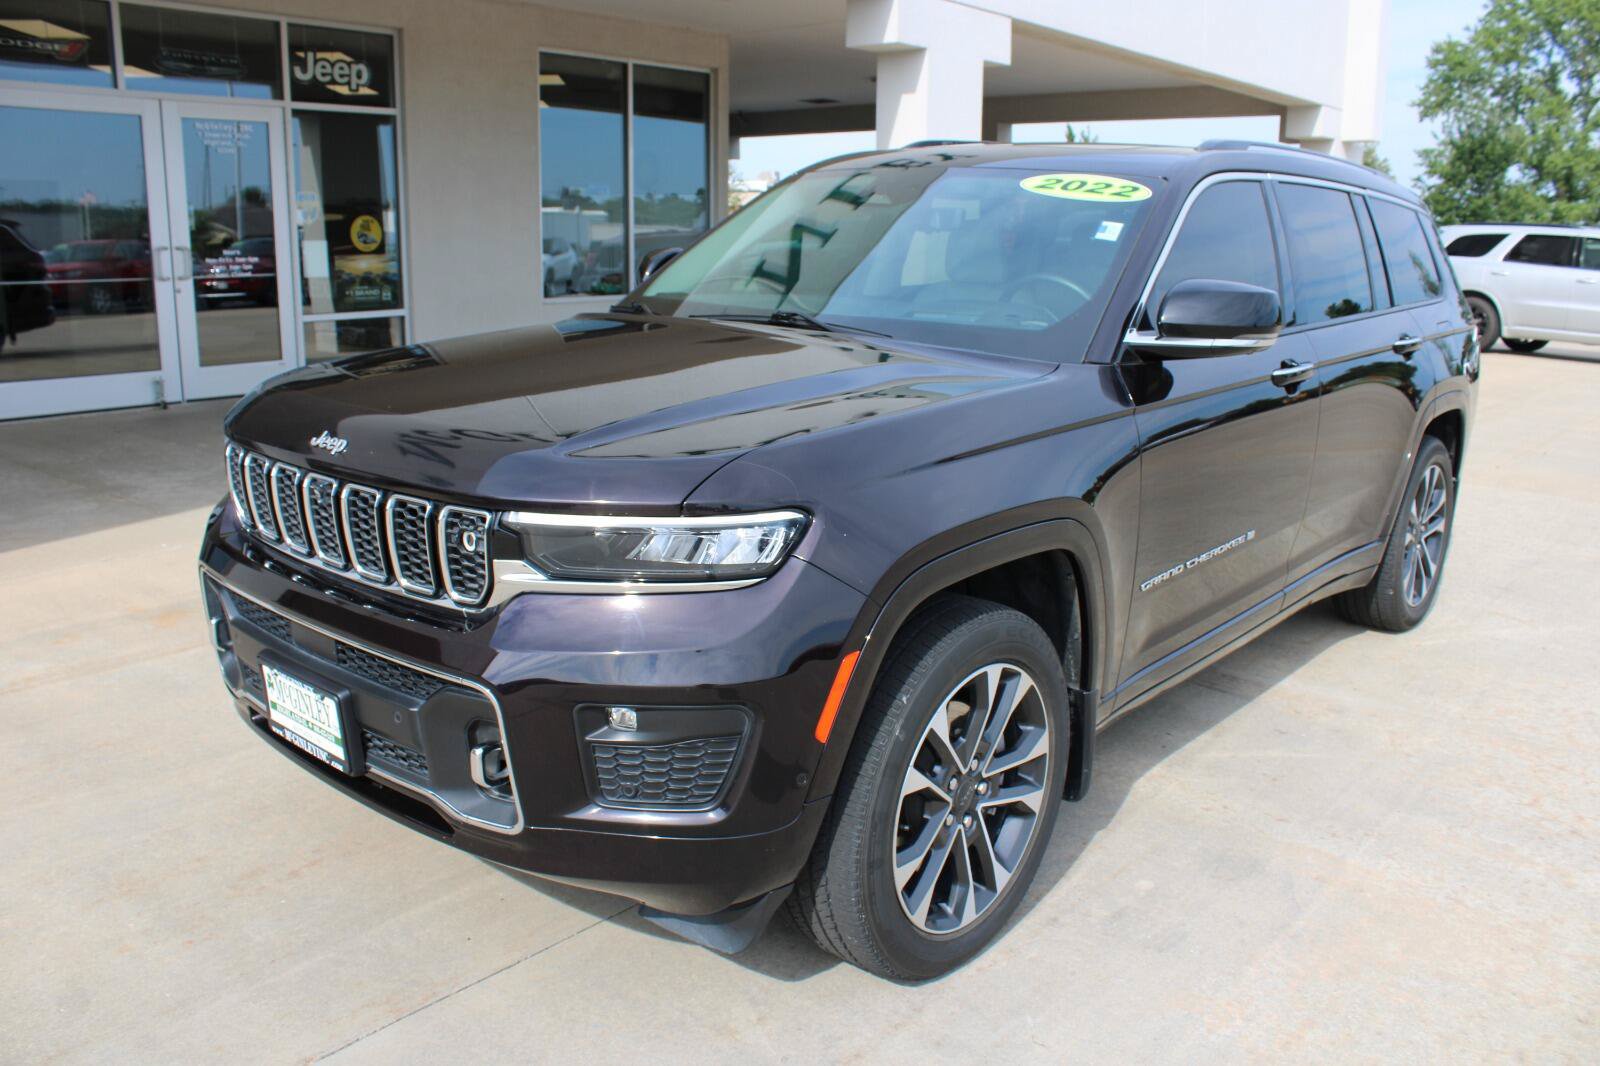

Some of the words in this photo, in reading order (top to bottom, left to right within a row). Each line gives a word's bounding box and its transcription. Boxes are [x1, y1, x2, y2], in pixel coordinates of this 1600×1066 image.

[293, 51, 368, 90] Jeep
[1033, 178, 1140, 198] 2022
[311, 430, 347, 455] Jeep
[1140, 564, 1184, 592] GRAND
[1185, 535, 1246, 569] CHEROKEE
